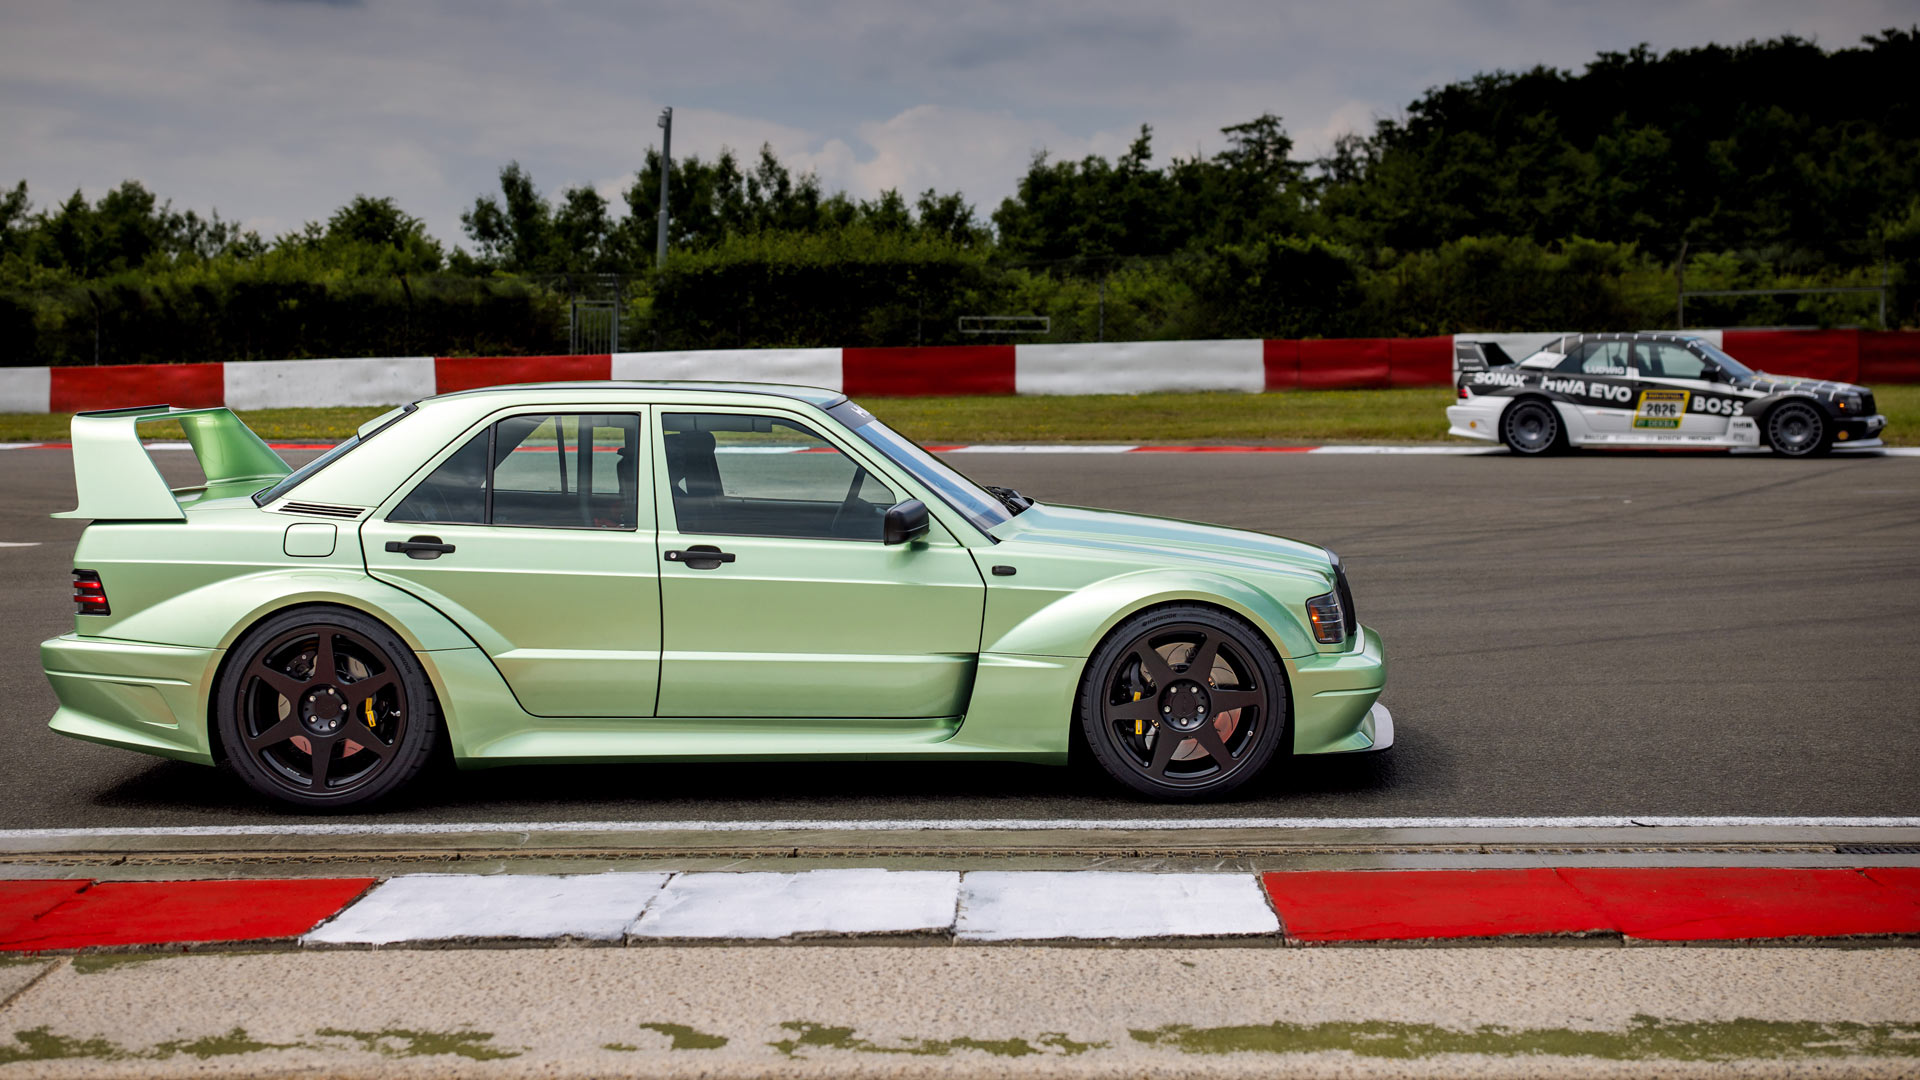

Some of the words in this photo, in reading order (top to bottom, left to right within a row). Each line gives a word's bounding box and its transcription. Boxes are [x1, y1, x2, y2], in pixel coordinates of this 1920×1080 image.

[1474, 372, 1525, 387] SONAX
[1540, 376, 1587, 395] HWA
[1589, 382, 1632, 402] EVO
[1646, 403, 1677, 417] 2026
[1692, 396, 1744, 415] BOSS
